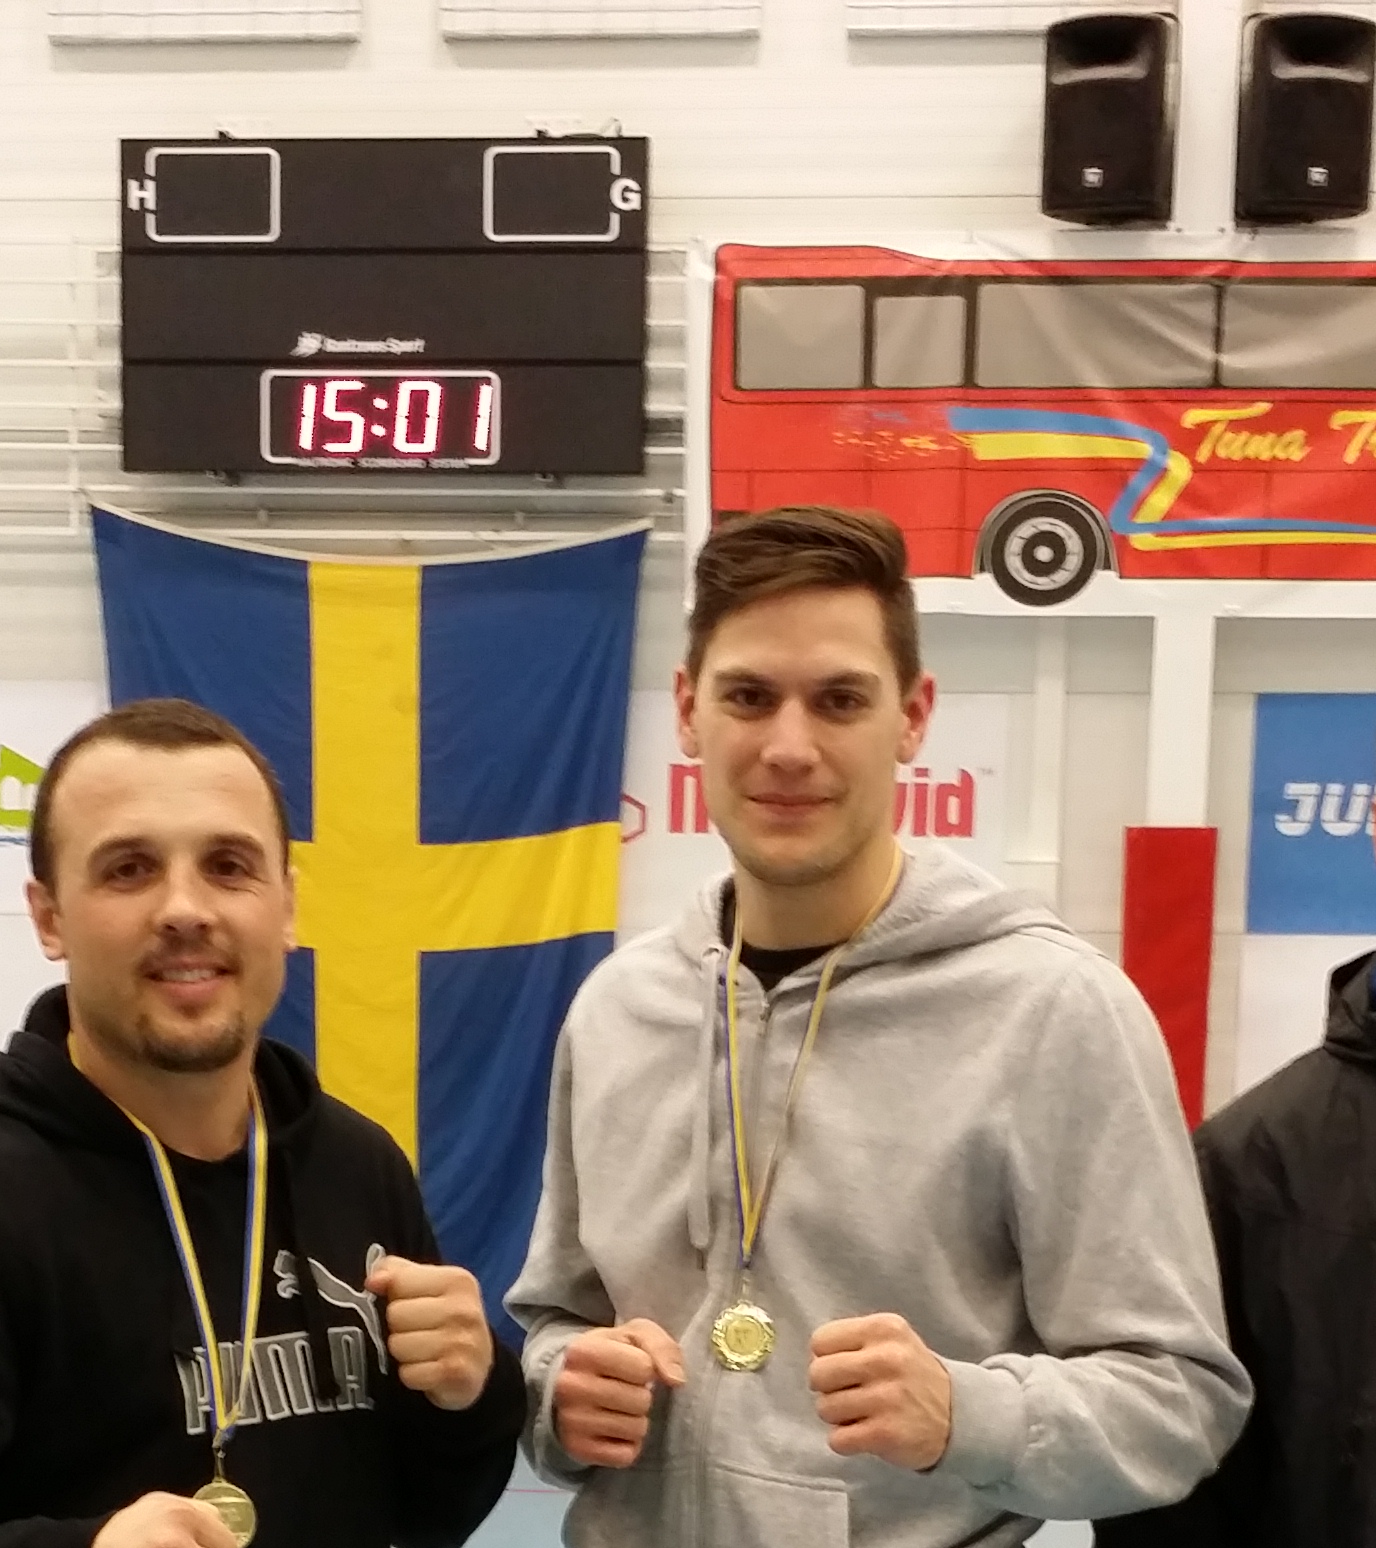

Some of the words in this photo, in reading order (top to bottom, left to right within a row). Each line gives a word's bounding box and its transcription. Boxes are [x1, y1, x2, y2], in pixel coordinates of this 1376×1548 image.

[126, 178, 157, 211] H
[609, 177, 642, 211] G
[297, 379, 494, 453] 15:01
[1180, 401, 1312, 464] Tuna
